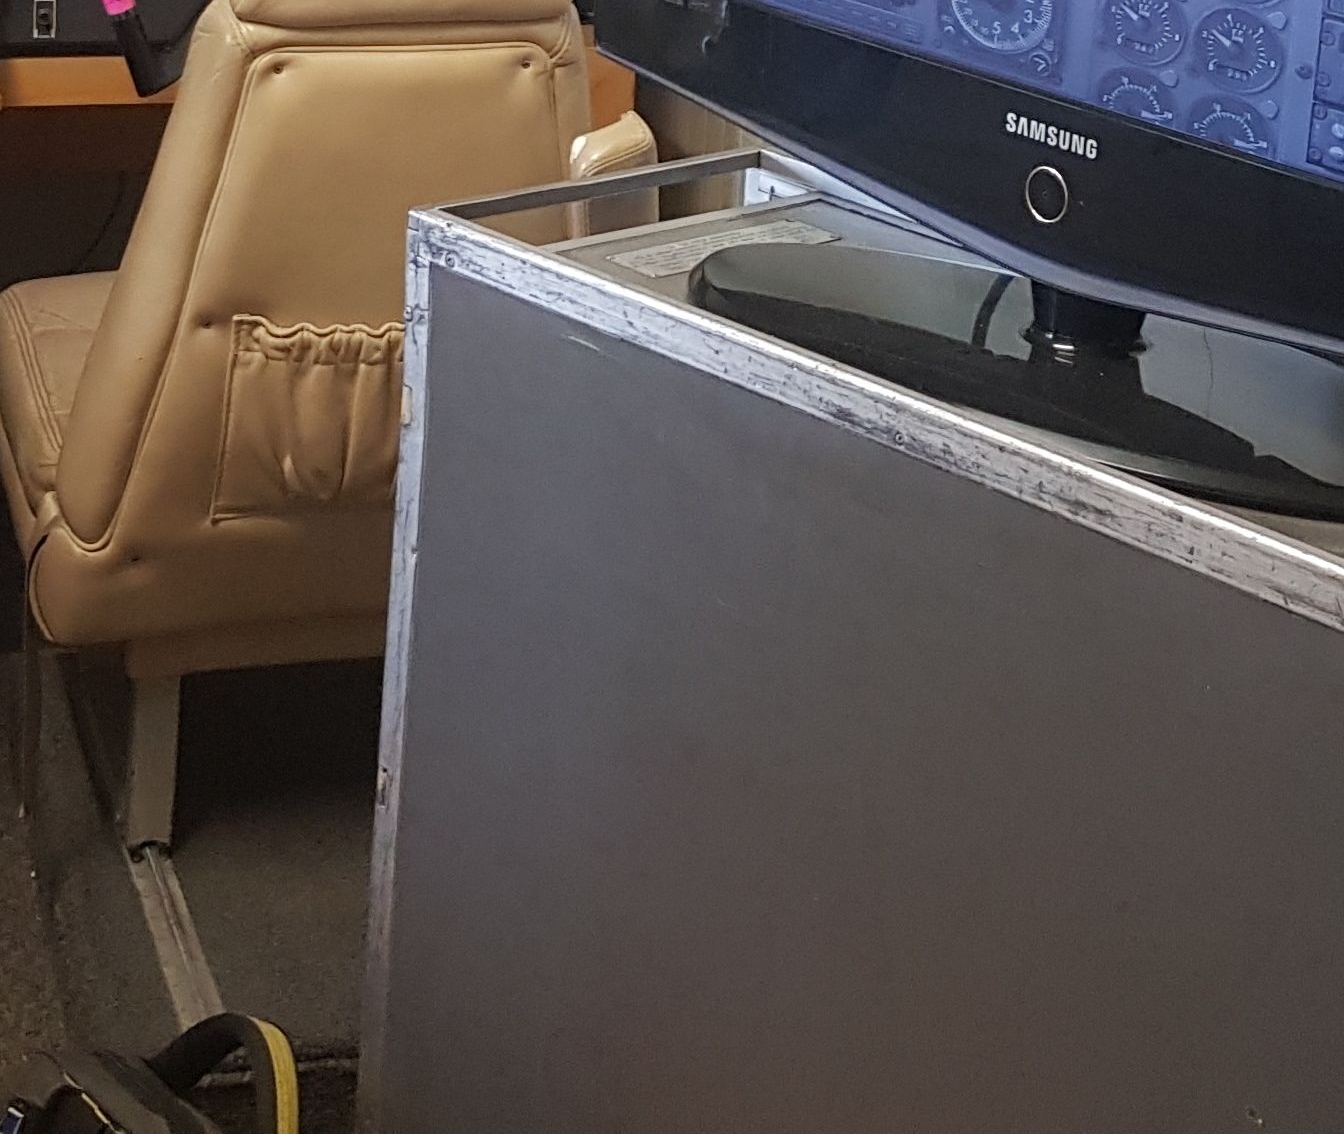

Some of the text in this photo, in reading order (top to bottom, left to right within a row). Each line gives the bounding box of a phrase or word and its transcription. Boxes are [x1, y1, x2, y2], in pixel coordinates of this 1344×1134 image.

[1024, 9, 1033, 23] 3
[992, 21, 1001, 34] 5
[1005, 112, 1098, 160] SAMSUNG
